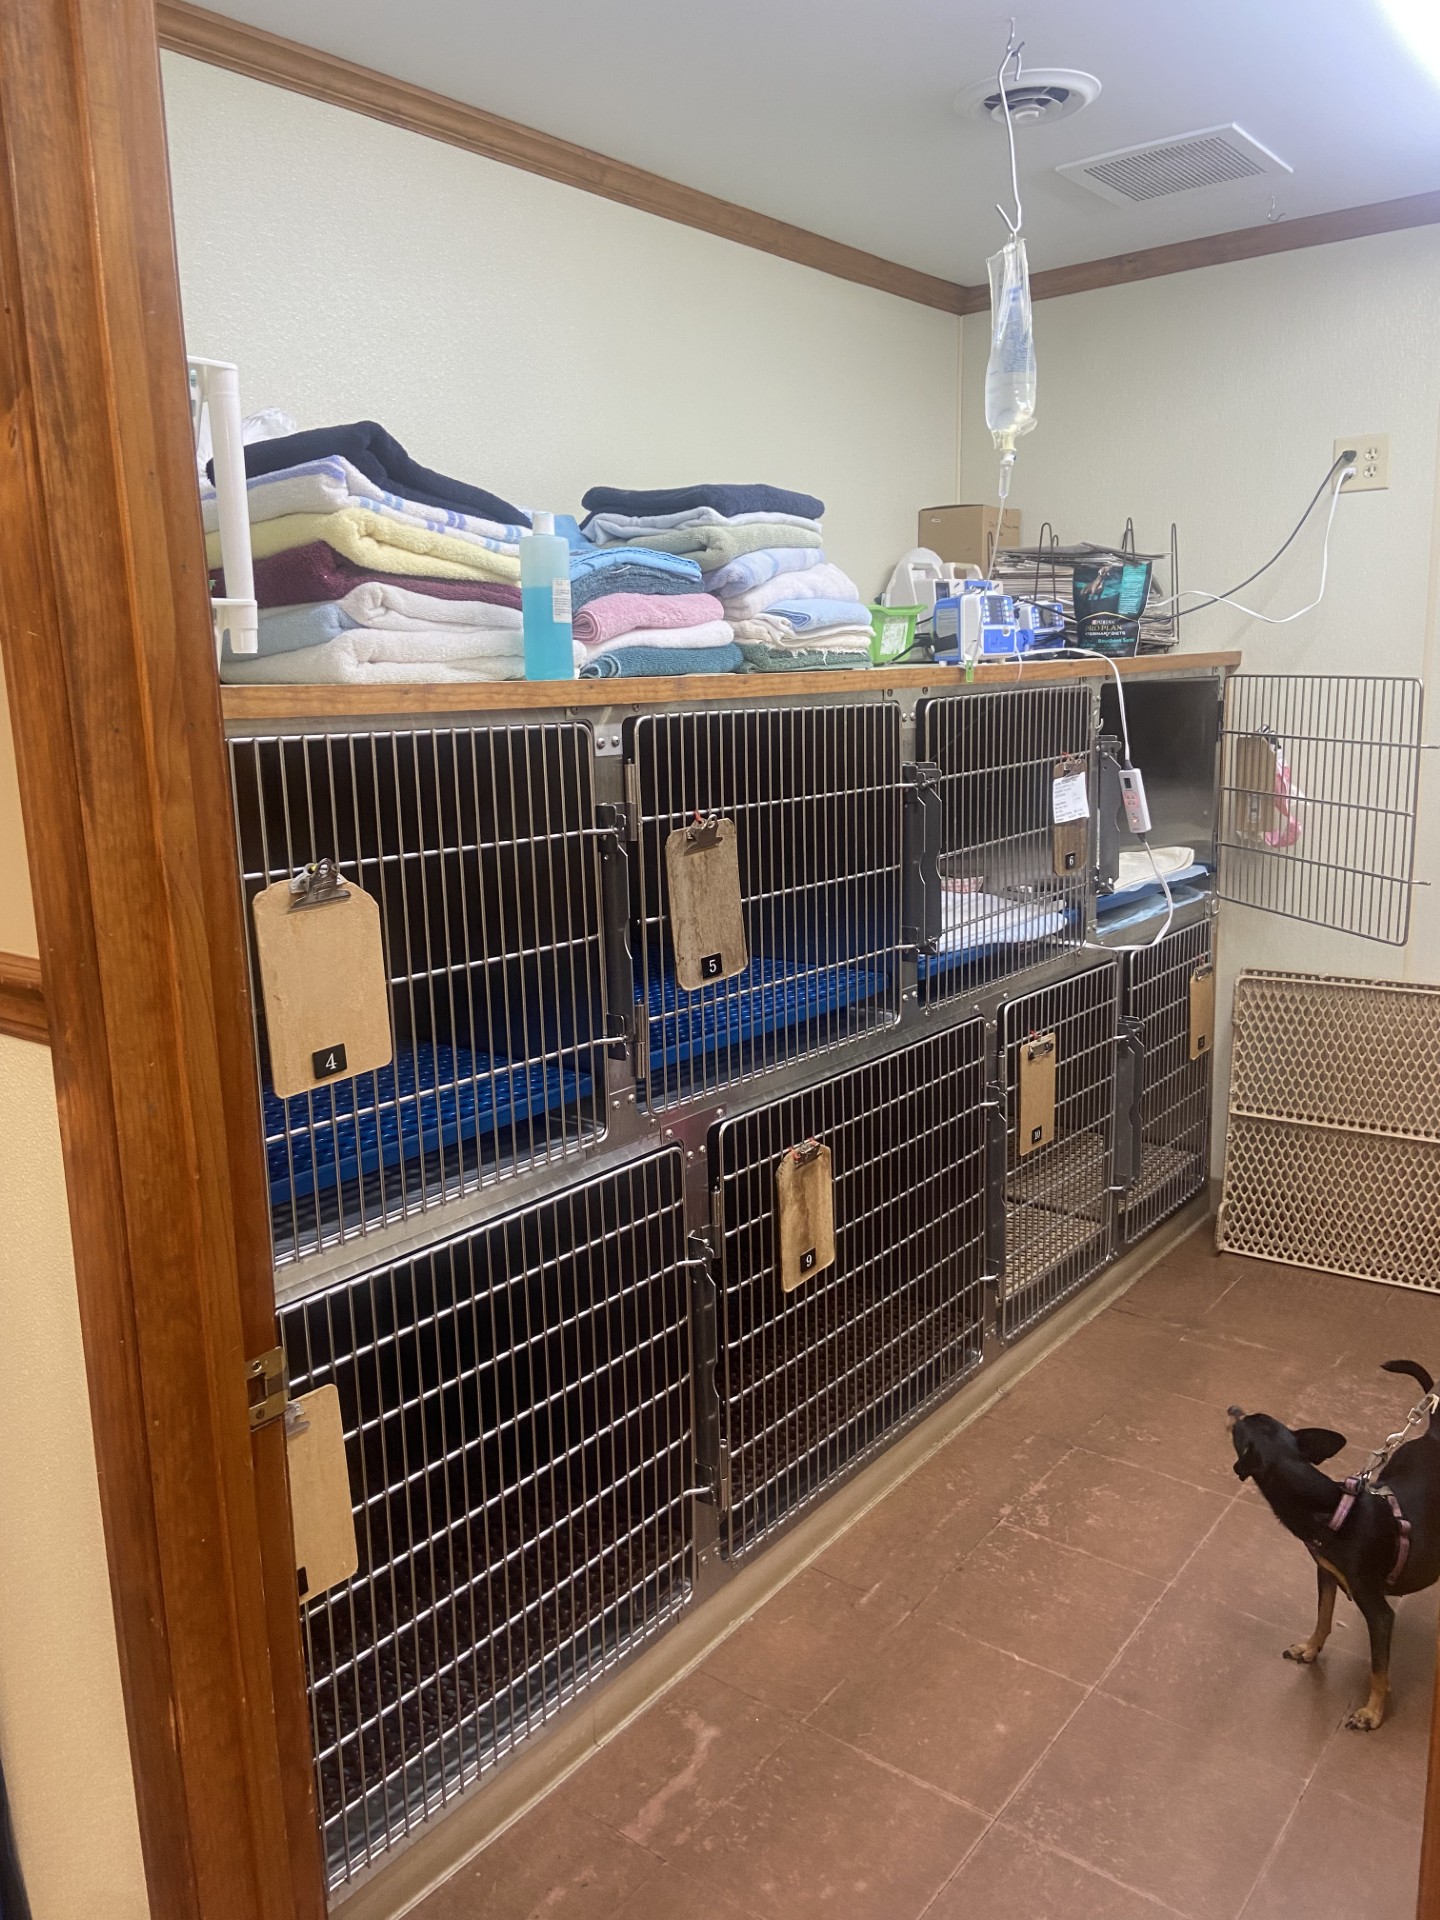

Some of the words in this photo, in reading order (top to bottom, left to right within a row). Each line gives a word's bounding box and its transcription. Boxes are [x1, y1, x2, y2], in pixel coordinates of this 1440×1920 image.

[1069, 855, 1074, 865] 6
[709, 959, 717, 973] 5
[325, 1052, 338, 1070] 4
[1034, 1129, 1041, 1140] 10
[806, 1254, 813, 1268] 9
